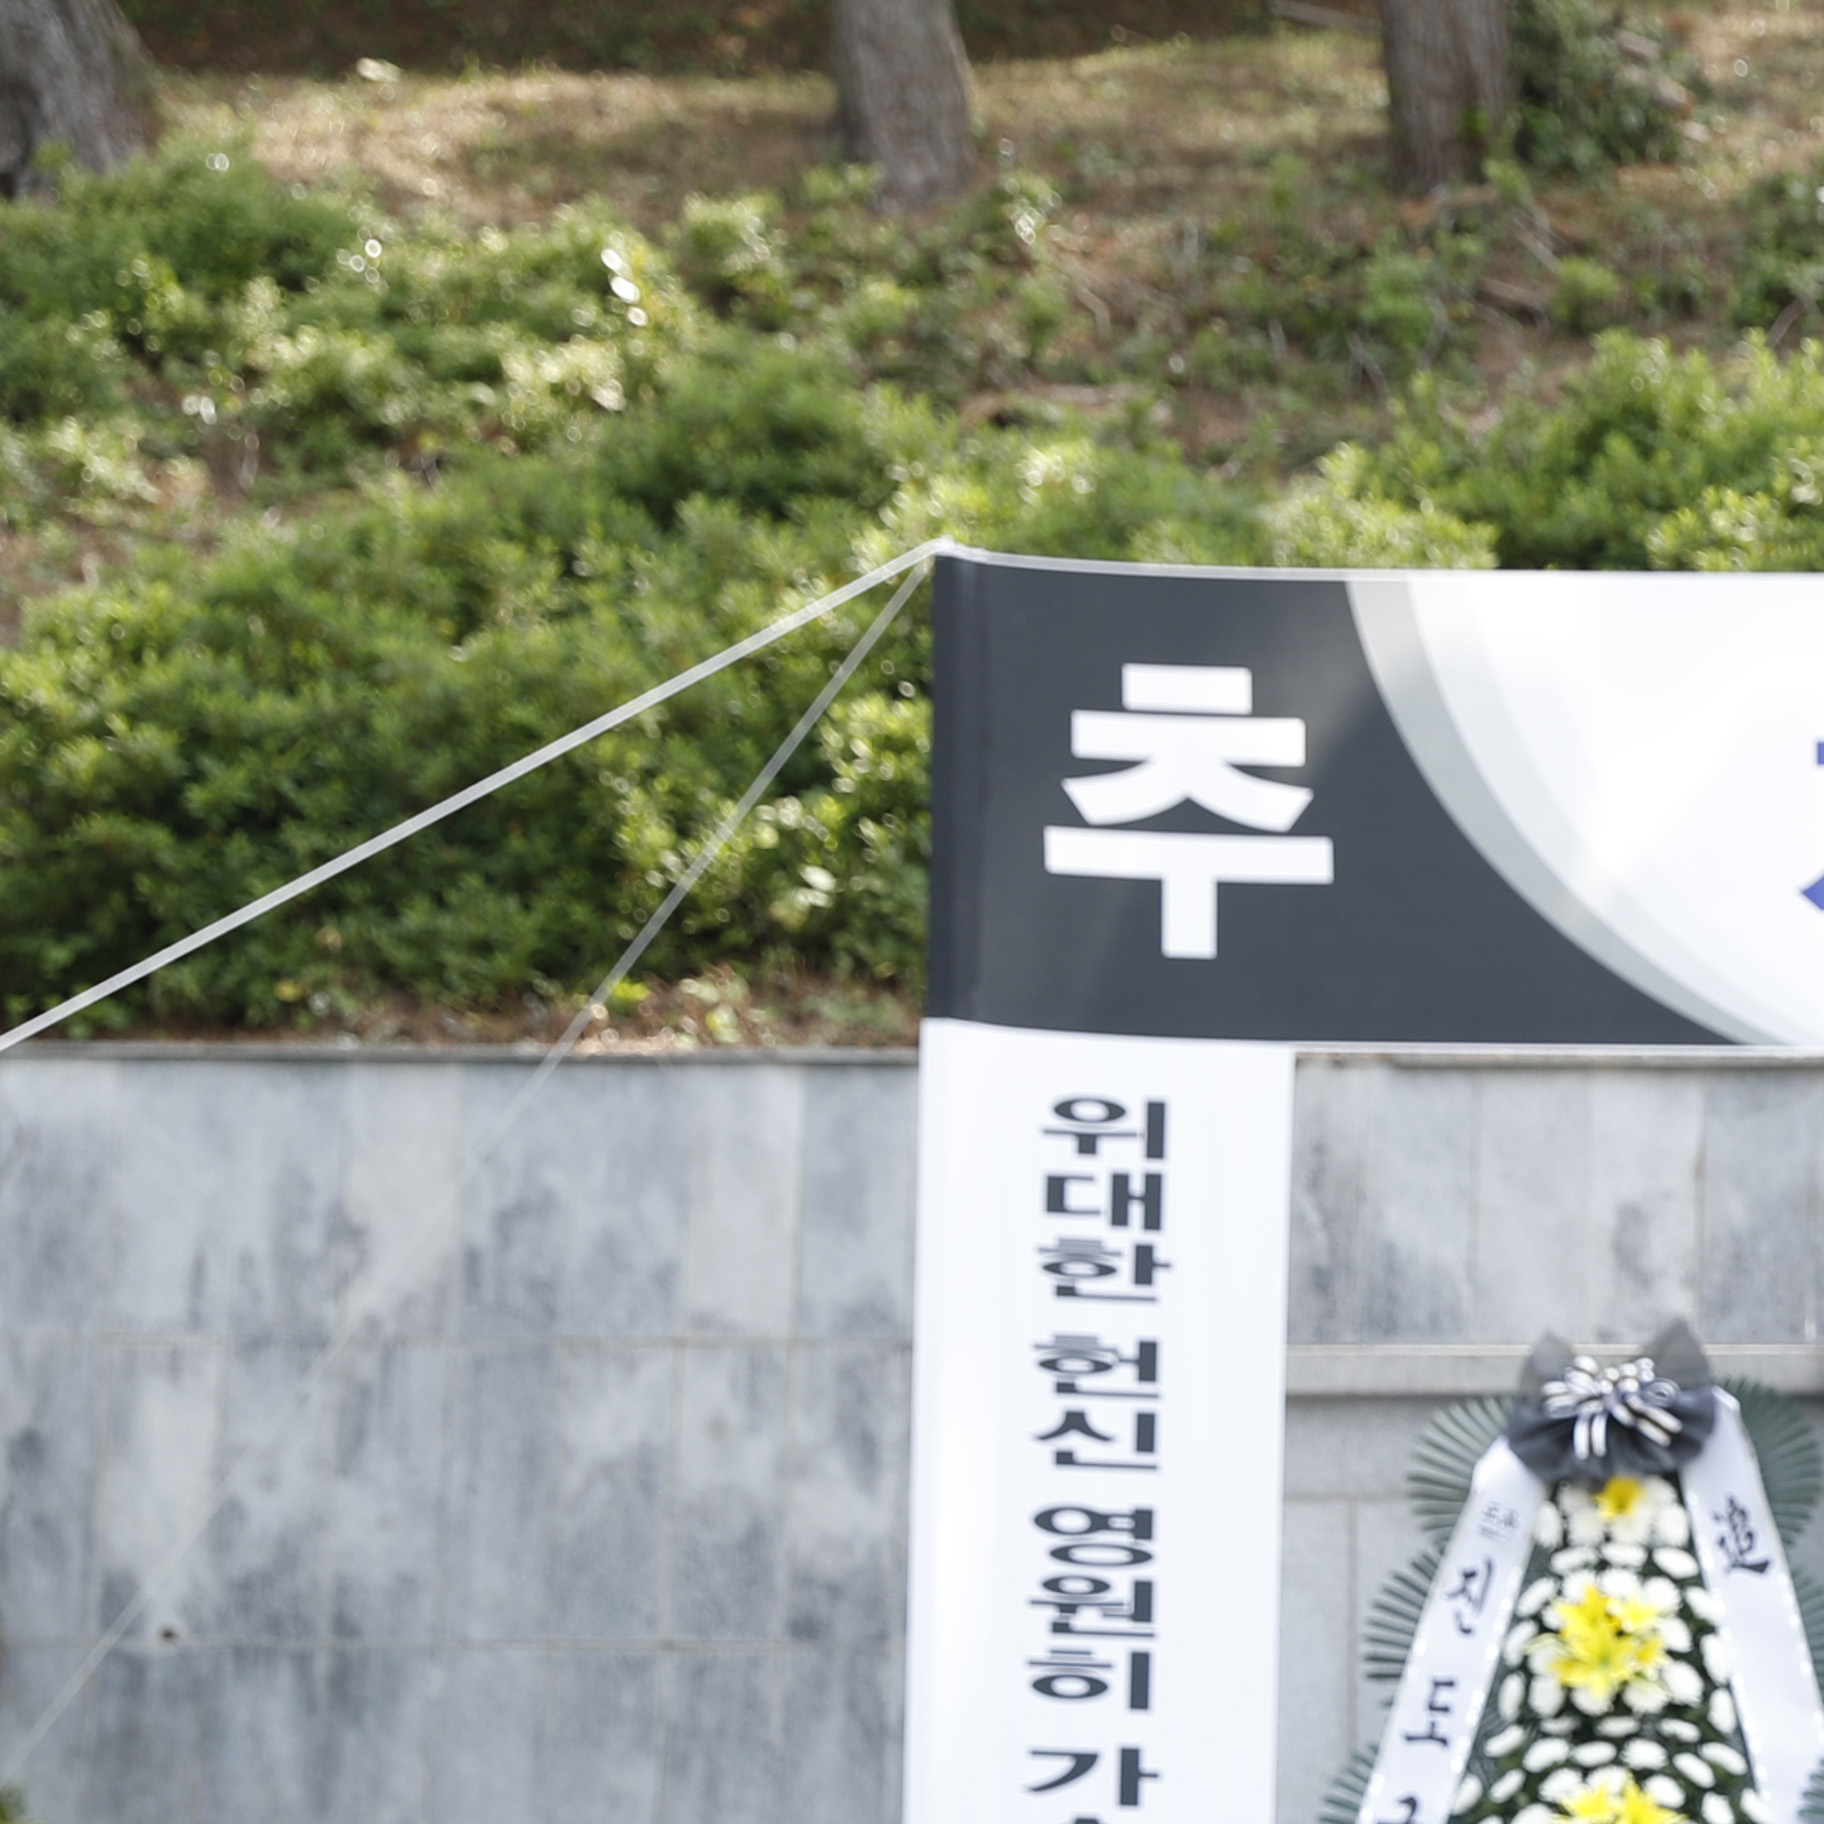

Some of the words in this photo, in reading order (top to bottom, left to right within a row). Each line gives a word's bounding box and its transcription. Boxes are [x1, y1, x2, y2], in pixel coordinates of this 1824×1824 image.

[1042, 662, 1335, 960] 추
[1037, 1096, 1173, 1304] 위대한
[1033, 1333, 1161, 1472] 헌신
[1026, 1505, 1157, 1713] 영원히
